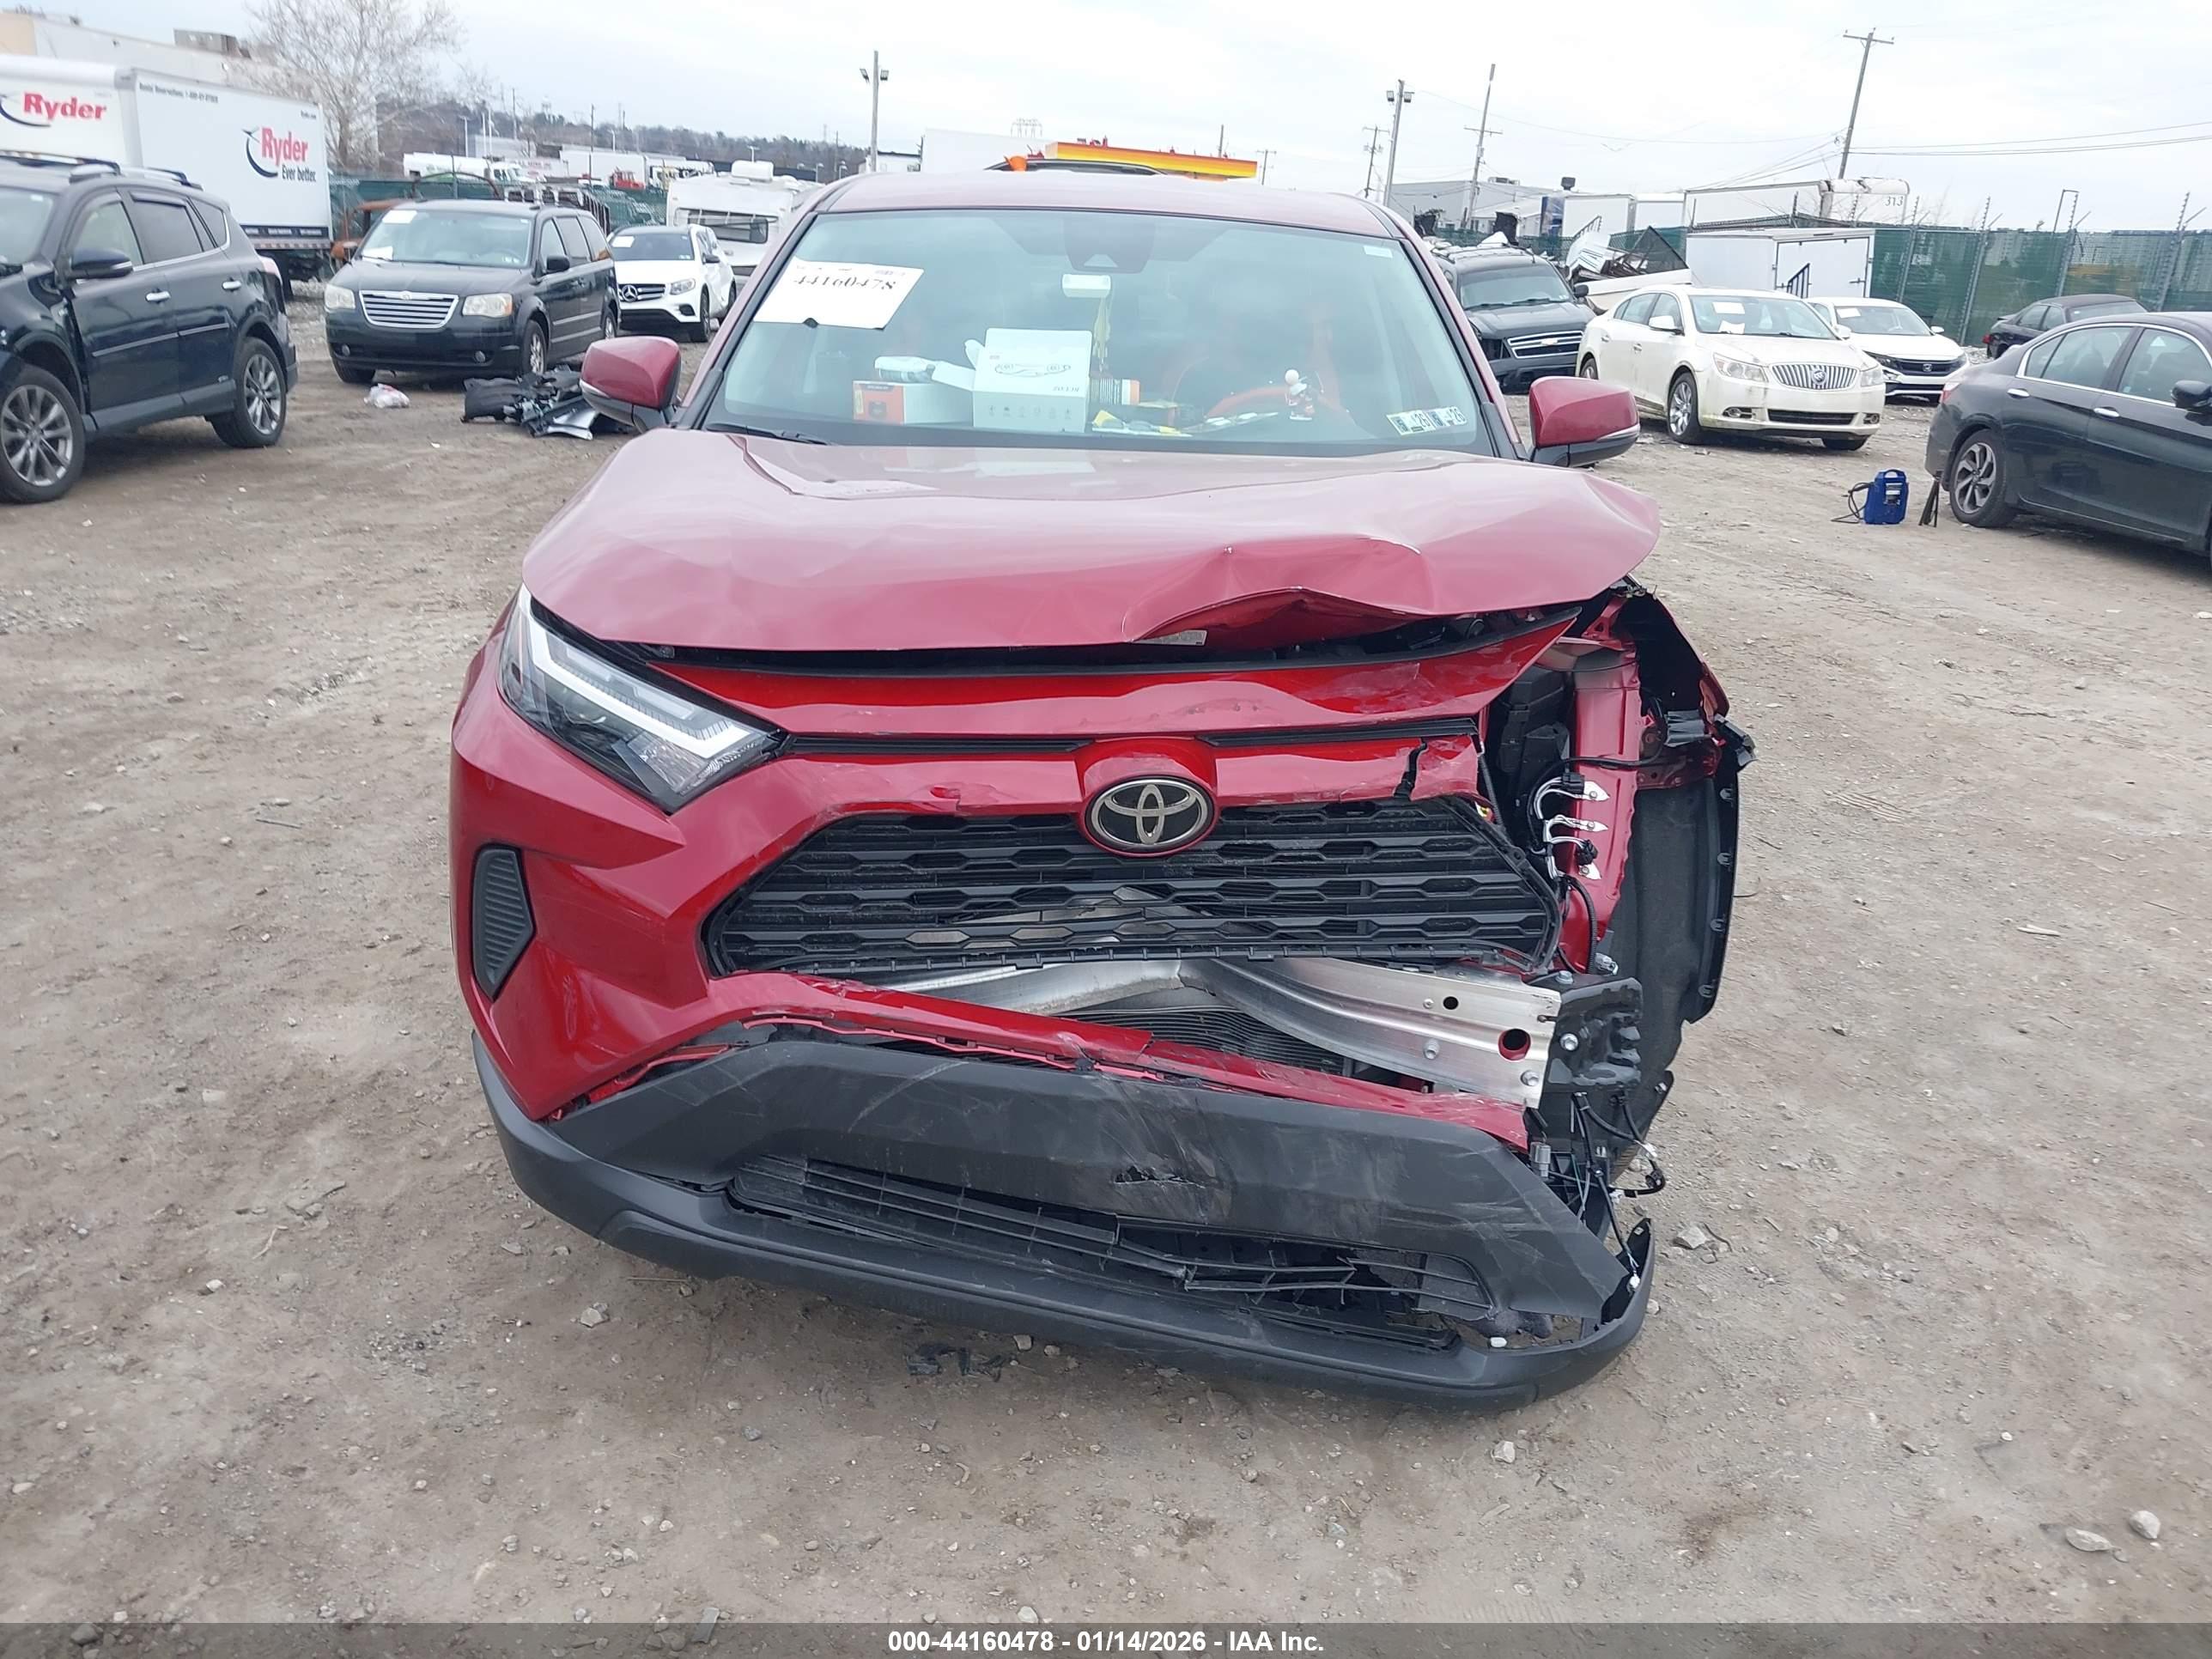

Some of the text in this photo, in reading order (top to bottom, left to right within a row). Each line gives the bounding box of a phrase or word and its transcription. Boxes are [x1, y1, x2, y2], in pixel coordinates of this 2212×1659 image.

[23, 92, 106, 120] Ryder
[261, 127, 308, 166] Ryder
[282, 164, 295, 180] Ever
[793, 274, 896, 291] 44160478
